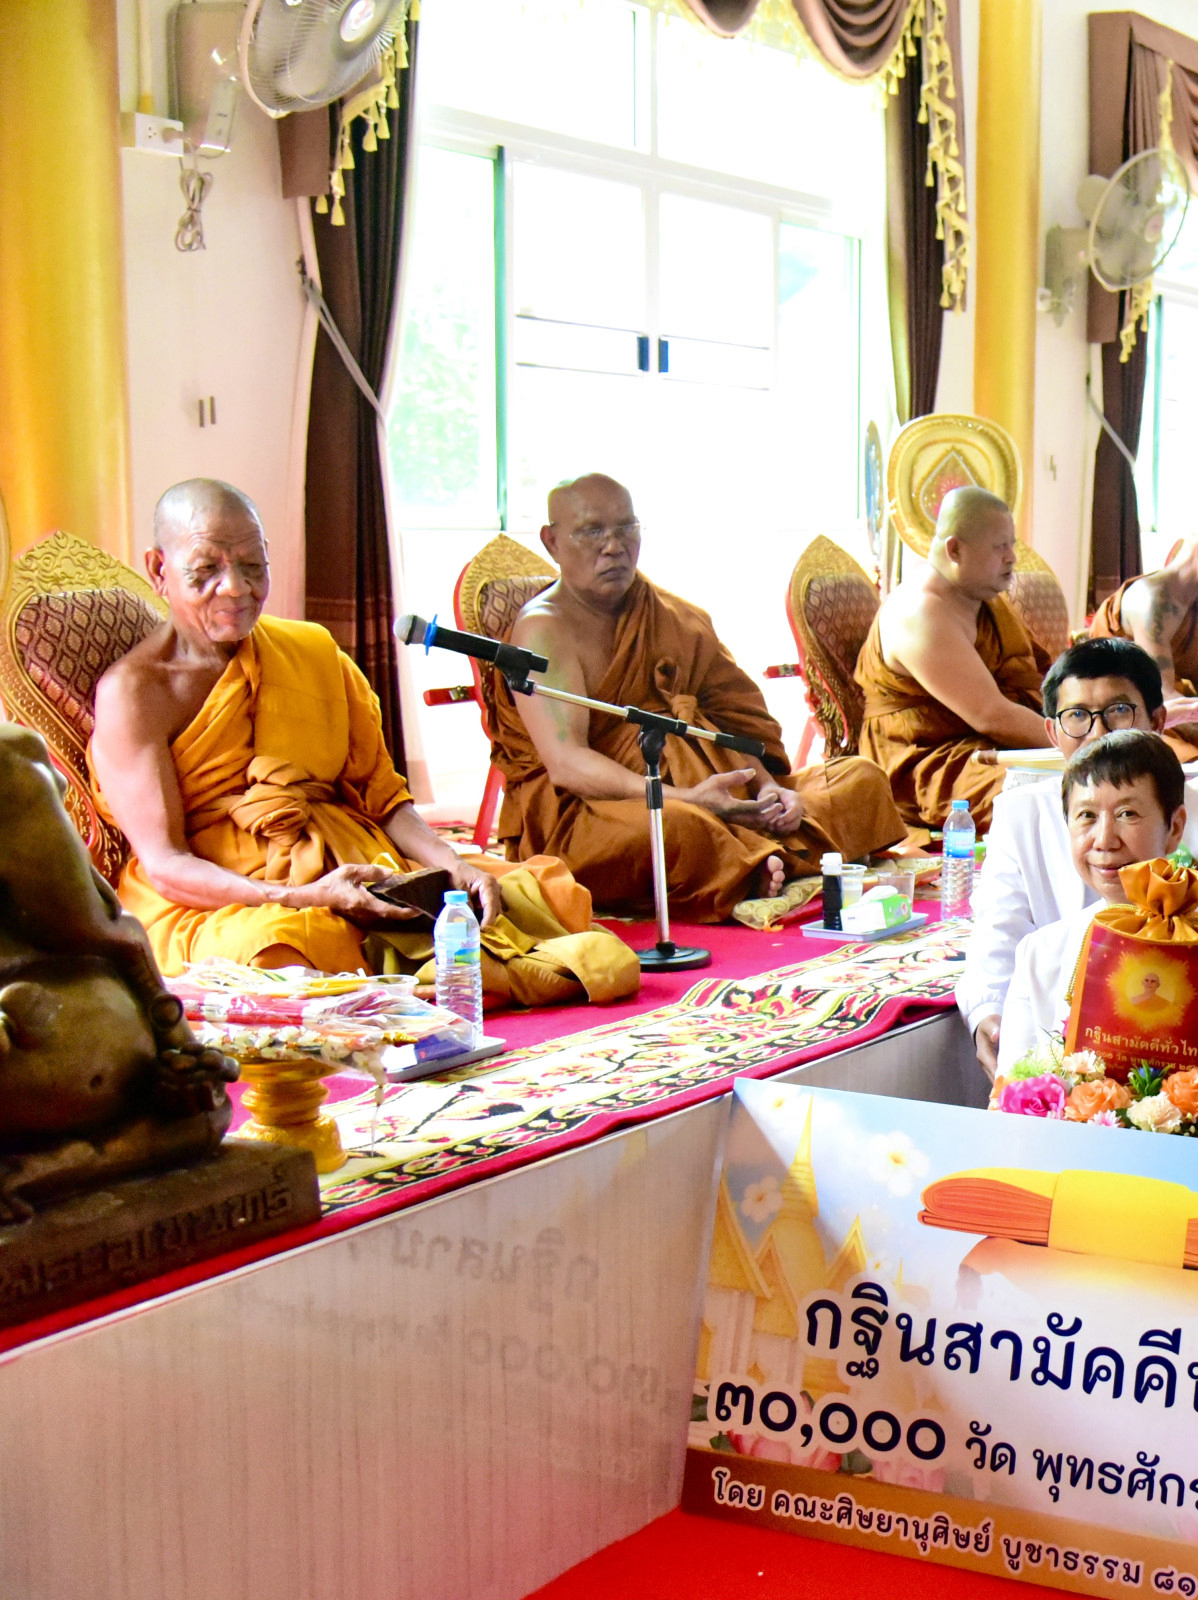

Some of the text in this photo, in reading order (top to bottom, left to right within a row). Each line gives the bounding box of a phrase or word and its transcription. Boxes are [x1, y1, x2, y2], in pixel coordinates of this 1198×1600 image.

[715, 1381, 946, 1461] ๓๐,๐๐๐
[965, 1420, 1017, 1476] วัด
[714, 1470, 763, 1507] โดย
[773, 1495, 992, 1552] คณะศิษยานุศิษย์
[1003, 1537, 1142, 1585] บูชาธรรม
[1153, 1570, 1197, 1597] ๘๑
